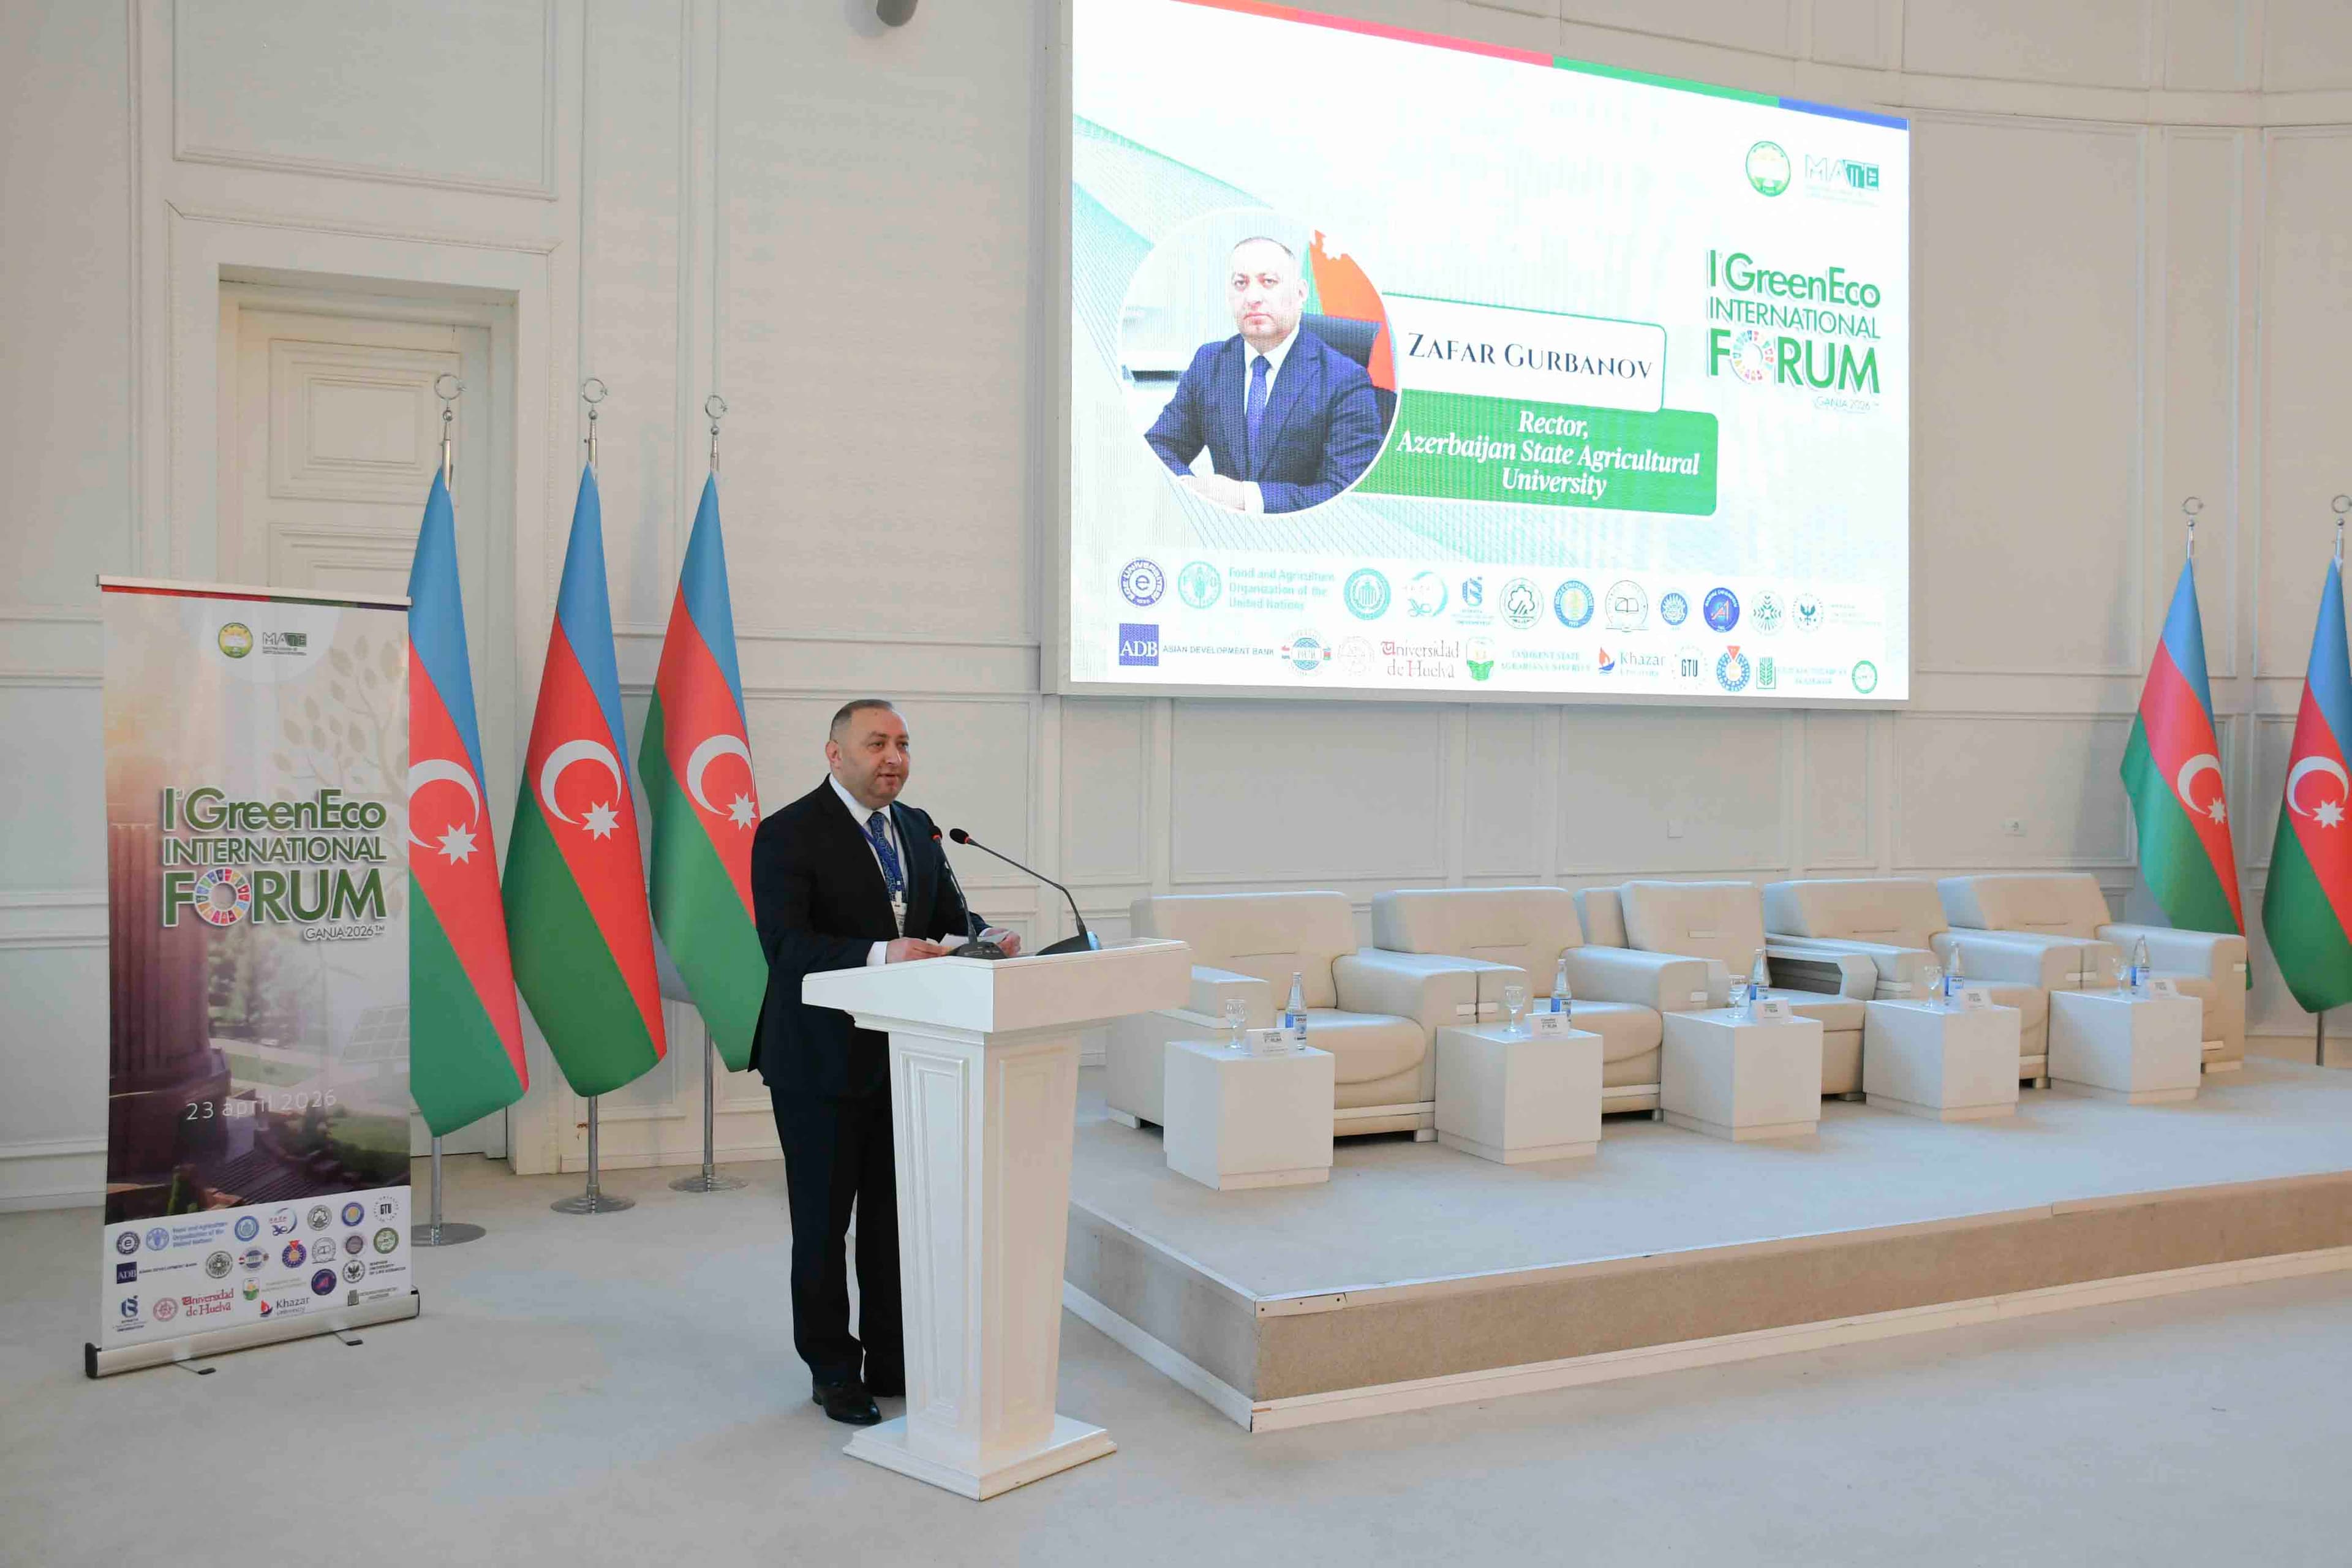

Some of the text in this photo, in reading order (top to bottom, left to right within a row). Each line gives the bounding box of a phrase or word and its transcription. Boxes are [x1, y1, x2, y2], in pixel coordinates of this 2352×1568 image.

[1725, 252, 1882, 309] GreenEco
[1709, 295, 1882, 339] INTERNATIONAL
[1408, 331, 1654, 380] ZAFAR GURBANOV
[1709, 327, 1881, 394] FORUM
[1518, 410, 1590, 440] Rector,
[1396, 430, 1700, 476] Azerbaijan State Agricultural
[1501, 466, 1608, 500] University
[1120, 639, 1159, 658] ADB
[1189, 646, 1250, 655] DEVELOPMENT
[1252, 647, 1275, 656] BANK
[1380, 639, 1460, 658] Universidad
[1619, 651, 1666, 666] Khazar
[1387, 658, 1455, 679] de Huelva
[1681, 658, 1698, 677] GTU
[185, 787, 387, 831] GreenEco
[164, 837, 387, 865] INTERNATIONAL
[164, 869, 387, 926] FORUM
[305, 926, 344, 940] GANJA
[186, 1088, 337, 1121] 23 april 2026
[380, 1204, 392, 1215] GTU
[117, 1268, 137, 1281] ADB
[181, 1287, 235, 1306] Universidad
[276, 1297, 311, 1309] Khazar
[186, 1302, 232, 1316] de Huelva
